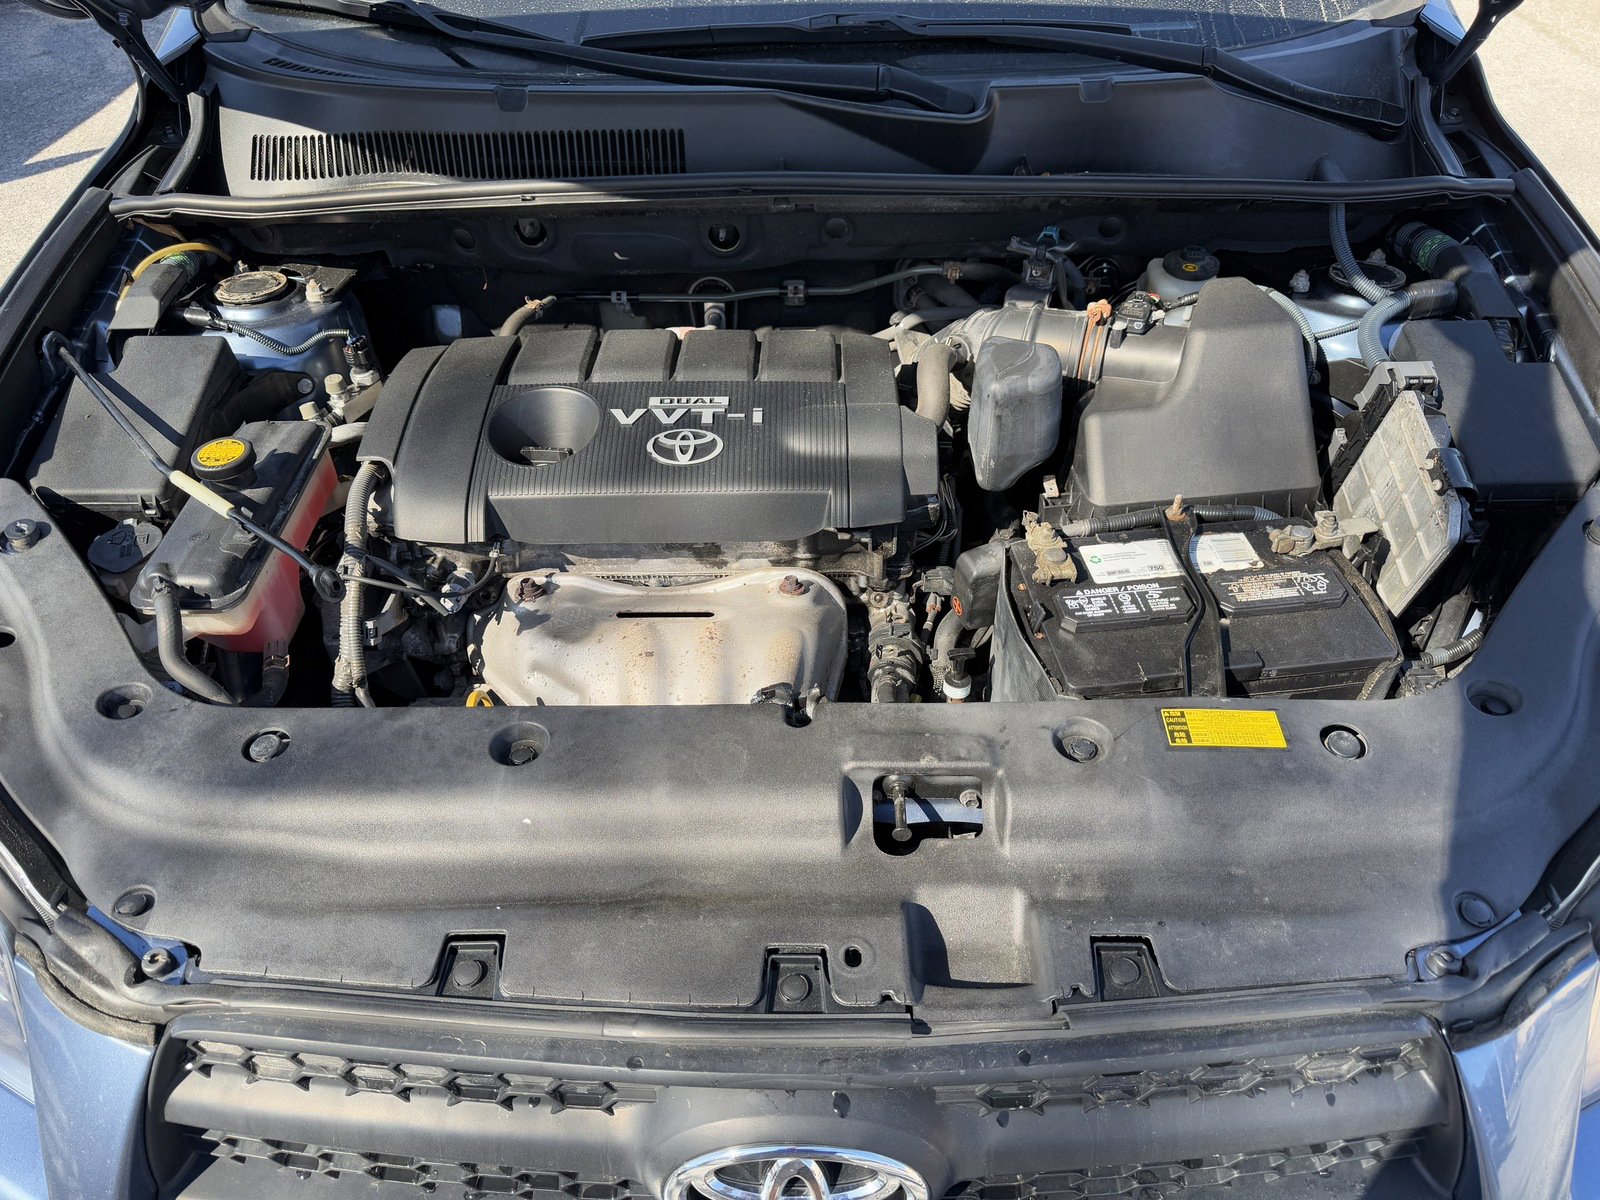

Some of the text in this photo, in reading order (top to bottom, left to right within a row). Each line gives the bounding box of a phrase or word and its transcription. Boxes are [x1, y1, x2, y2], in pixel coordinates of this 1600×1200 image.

[659, 397, 722, 405] DUAL
[609, 407, 763, 426] VVT-i
[1084, 586, 1119, 595] DANGER
[1127, 582, 1160, 591] POISON
